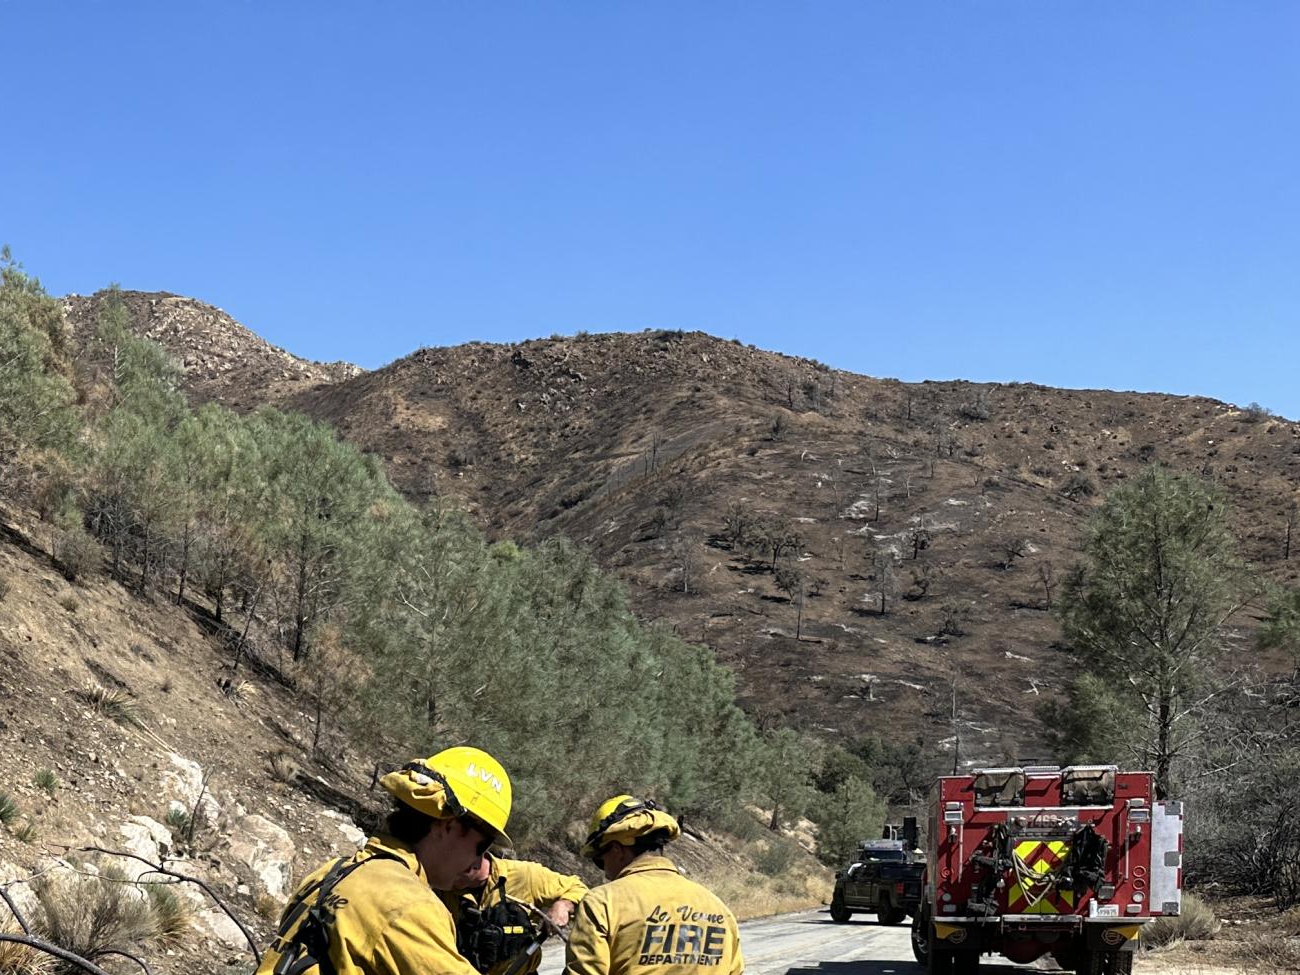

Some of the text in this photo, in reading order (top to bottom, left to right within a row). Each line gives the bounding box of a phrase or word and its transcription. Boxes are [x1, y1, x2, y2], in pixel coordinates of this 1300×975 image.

[646, 905, 671, 924] La
[641, 924, 726, 955] FIRE
[638, 954, 723, 966] DEPARTMENT
